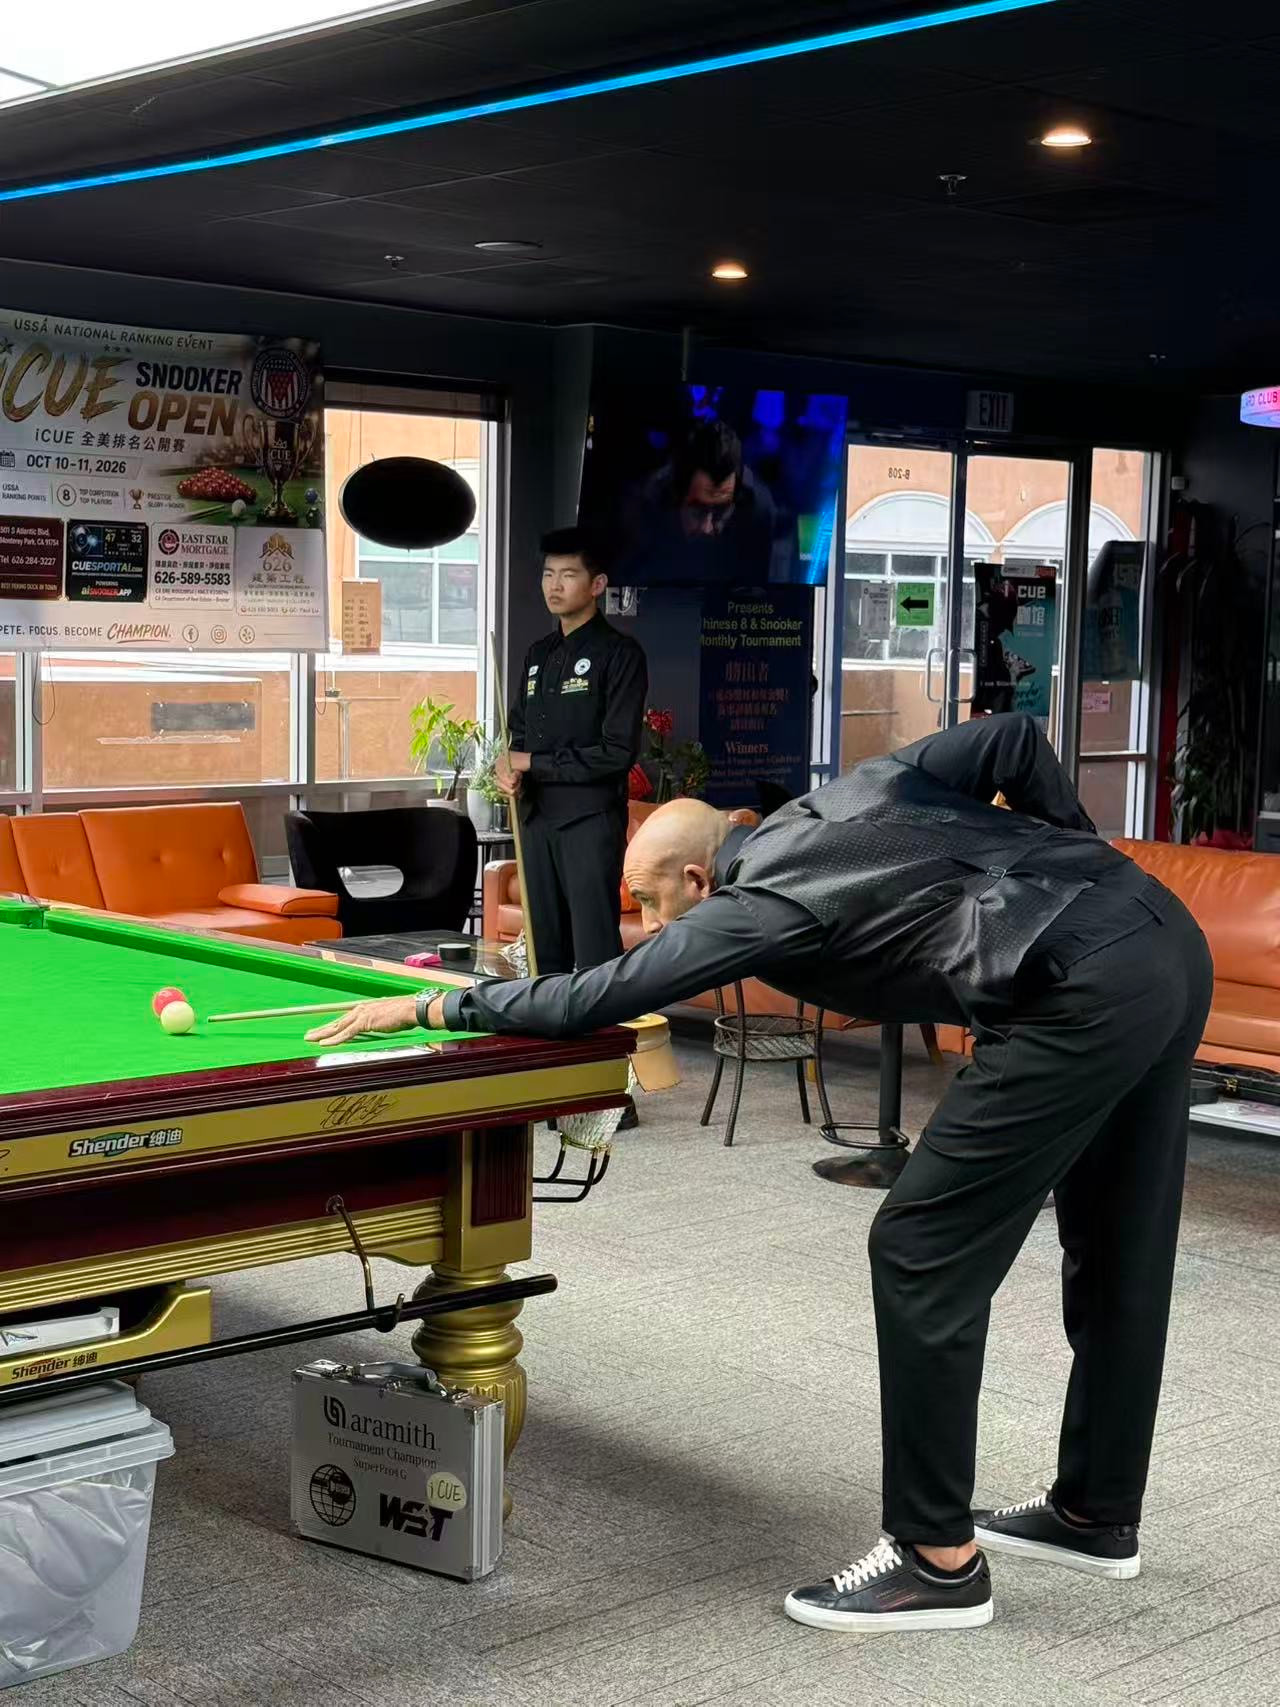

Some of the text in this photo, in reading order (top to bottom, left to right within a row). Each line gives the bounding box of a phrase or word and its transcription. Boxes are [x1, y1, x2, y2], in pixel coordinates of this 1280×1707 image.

[54, 323, 117, 342] NATIONAL
[120, 328, 173, 346] RANKING
[177, 334, 214, 351] EVENT
[136, 361, 243, 396] SNOOKER
[1258, 391, 1278, 405] CLUB
[127, 390, 236, 437] OPEN
[35, 427, 186, 453] iCUE 全美排名公開賽
[26, 454, 127, 475] OCT 10-11, 2026
[62, 490, 70, 501] 8
[181, 533, 229, 545] EAST STAR
[181, 545, 230, 556] MORTGAGE
[11, 556, 24, 564] 626
[25, 557, 57, 566] 284-3227
[262, 557, 293, 573] 626
[154, 571, 231, 586] 626-589-5583
[29, 625, 61, 636] FOCUS.
[64, 626, 103, 637] BECOME
[107, 622, 173, 641] CHAMPION.
[740, 617, 748, 630] 8
[750, 617, 759, 630] &
[760, 617, 803, 630] Snooker
[740, 634, 802, 647] Tournament
[70, 1128, 183, 1157] Shender 绅迪
[11, 1357, 72, 1380] Shender
[350, 1412, 437, 1451] aramith
[328, 1432, 437, 1470] Tournament Champion
[379, 1492, 454, 1542] WST
